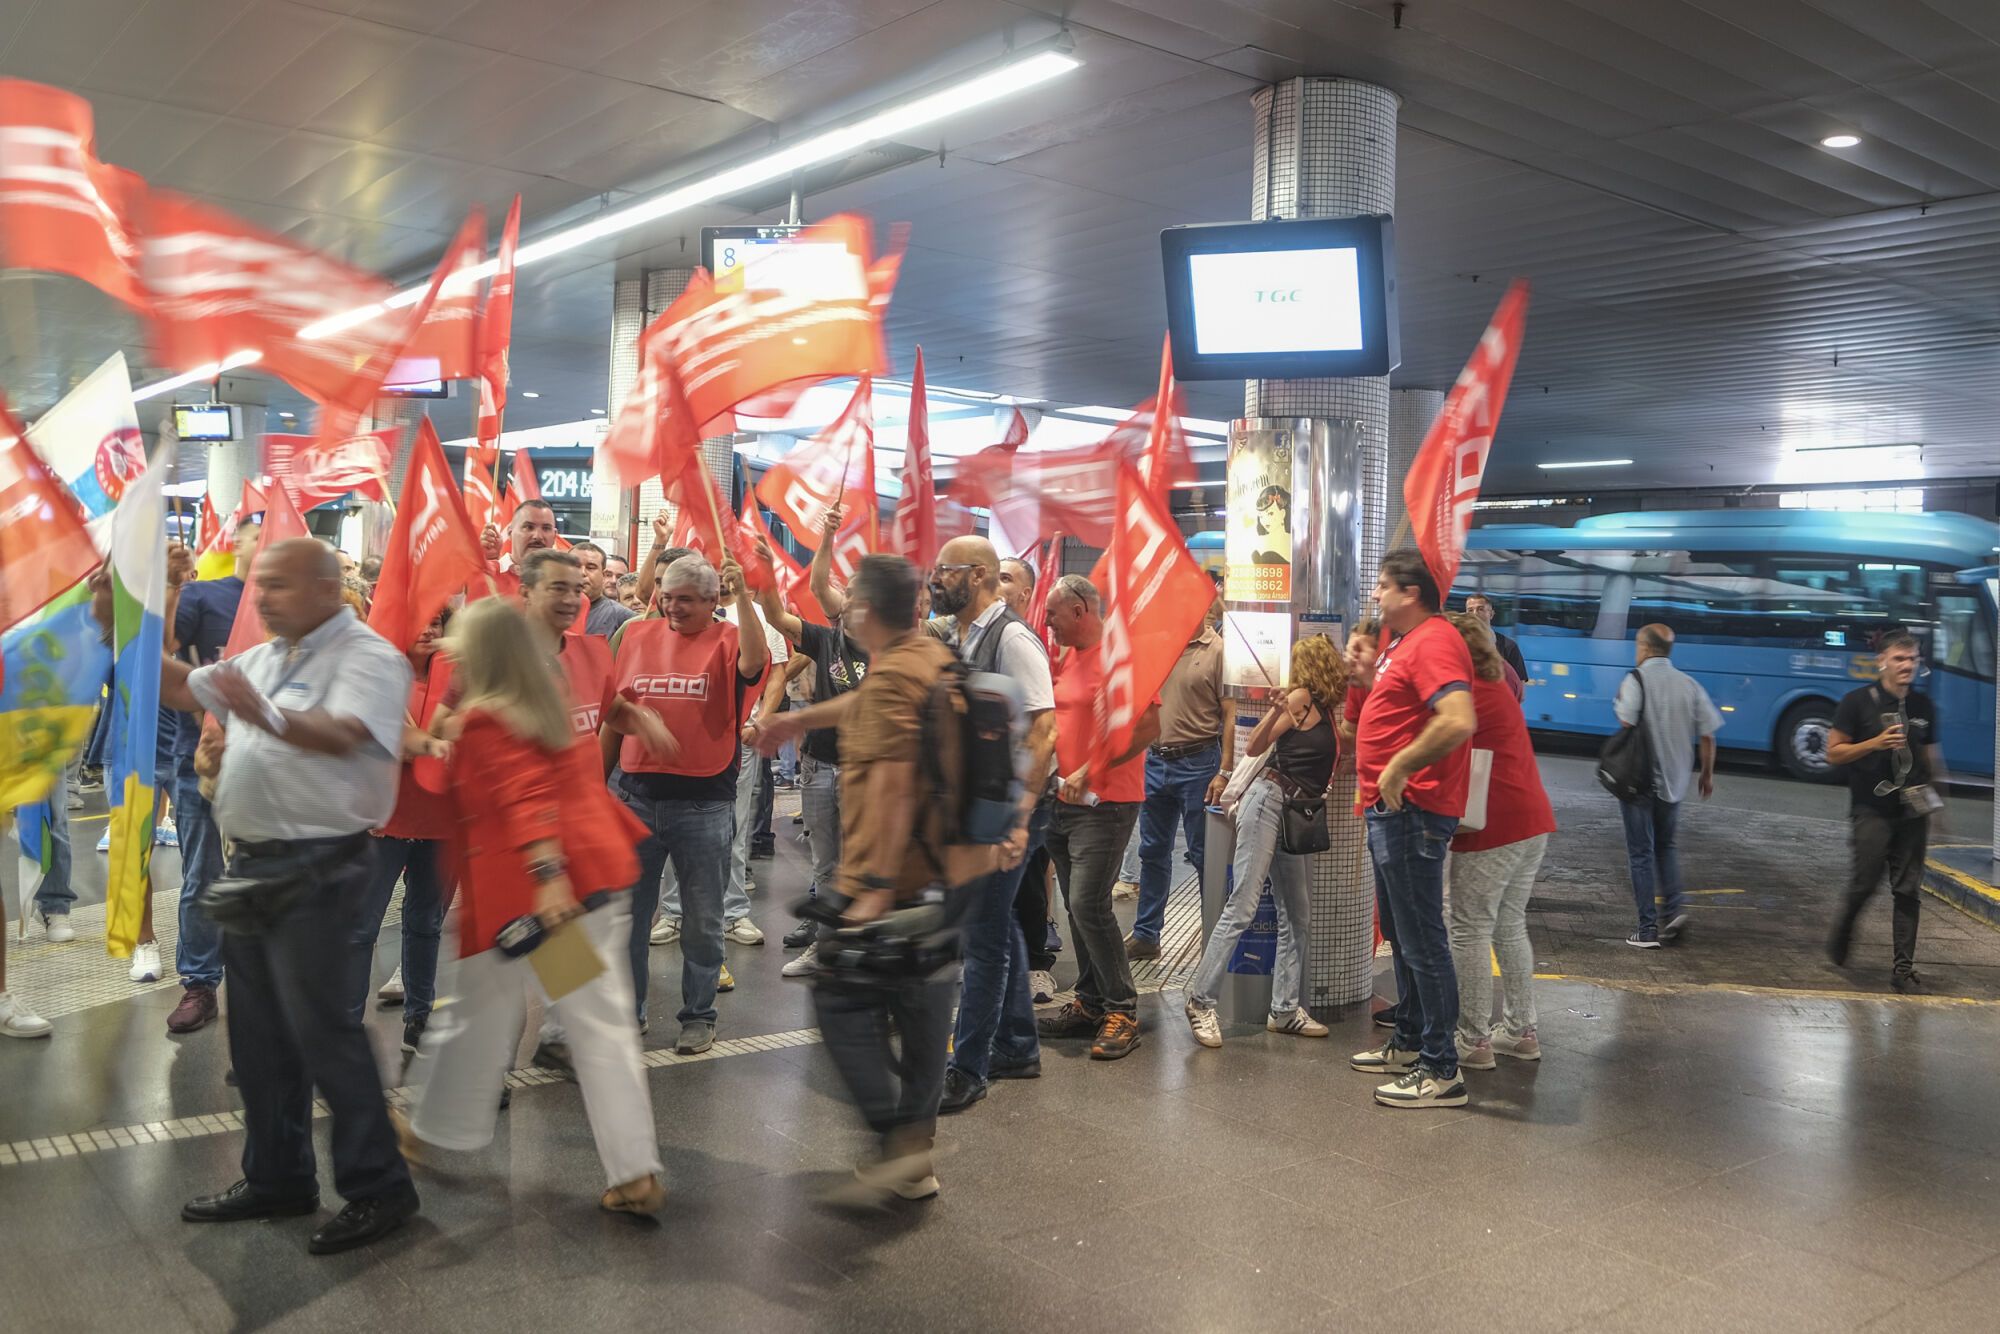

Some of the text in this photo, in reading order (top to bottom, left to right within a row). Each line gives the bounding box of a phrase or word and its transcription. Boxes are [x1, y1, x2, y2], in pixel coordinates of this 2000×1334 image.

[723, 247, 736, 268] 8
[1253, 288, 1304, 303] TGC
[540, 470, 579, 498] 204
[633, 677, 706, 695] CCOO
